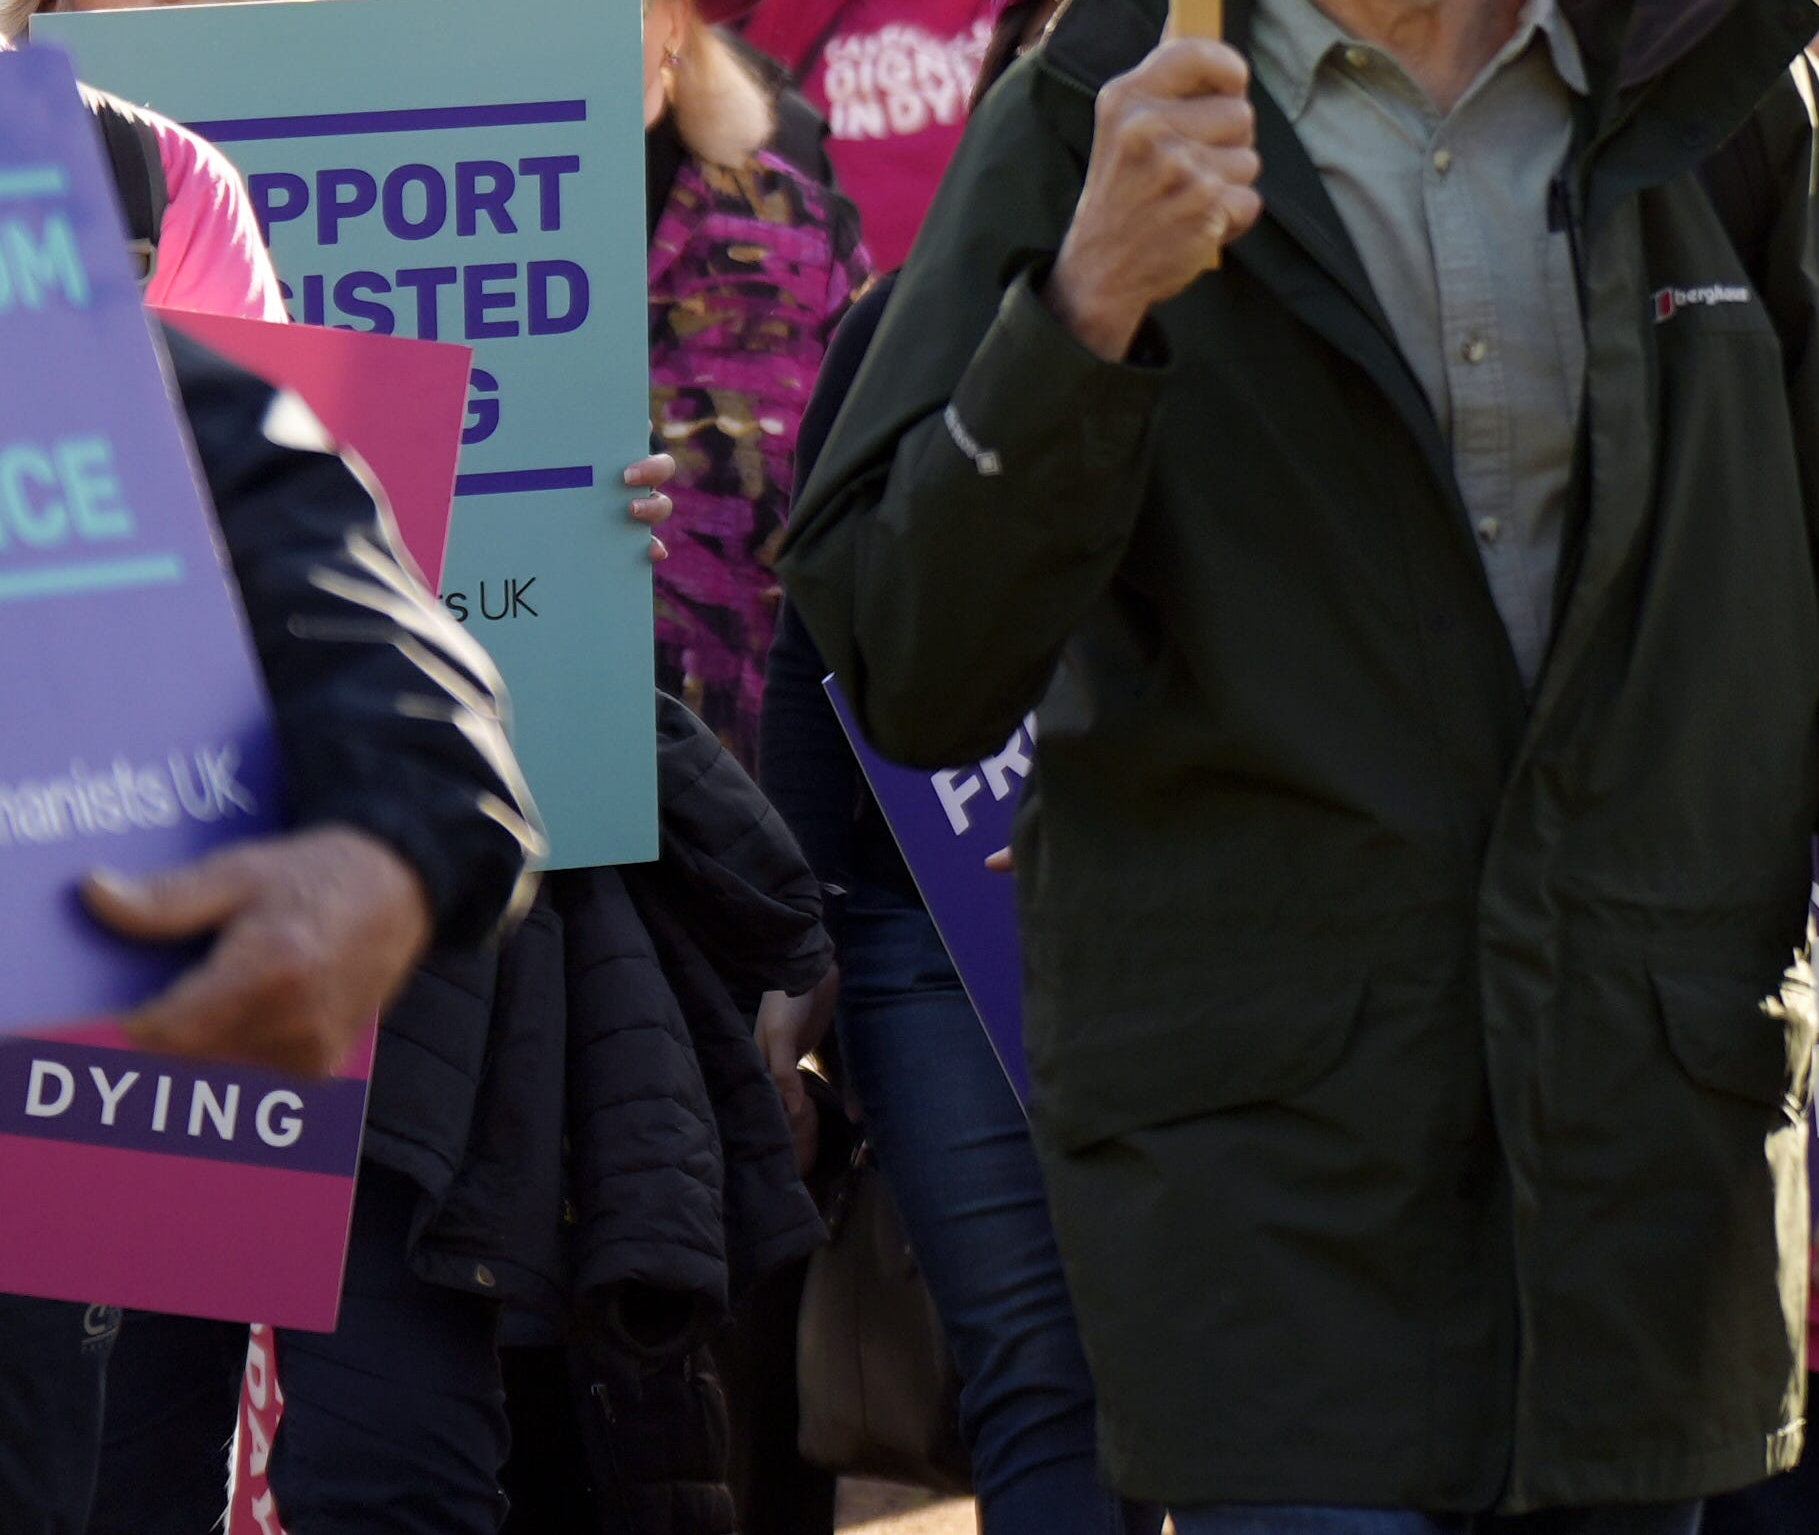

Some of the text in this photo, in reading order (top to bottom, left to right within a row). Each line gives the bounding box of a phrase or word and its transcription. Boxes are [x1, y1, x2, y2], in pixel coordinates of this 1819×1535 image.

[247, 154, 580, 248] PPORT
[275, 259, 590, 342] ISTED
[480, 576, 539, 621] UK
[25, 1058, 305, 1148] DYING
